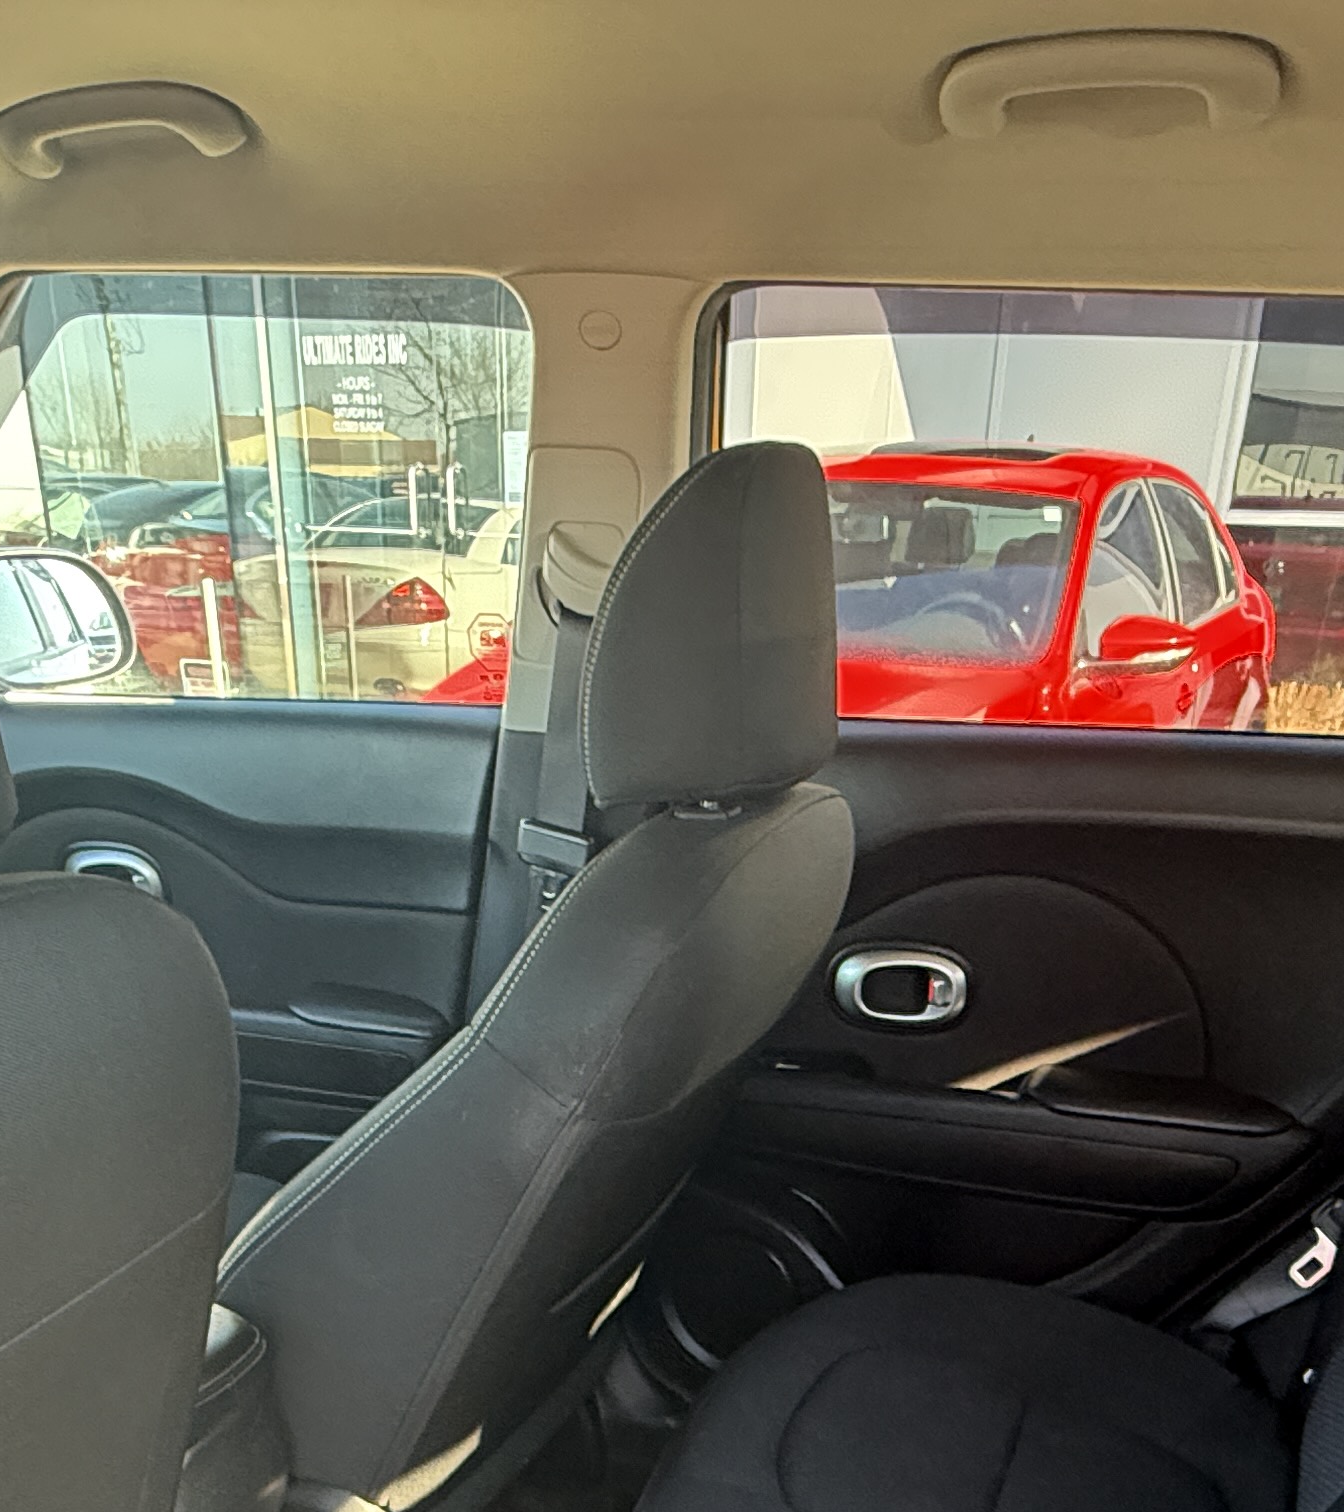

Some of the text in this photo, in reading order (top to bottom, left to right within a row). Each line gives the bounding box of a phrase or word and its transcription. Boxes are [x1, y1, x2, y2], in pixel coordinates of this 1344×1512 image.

[302, 333, 408, 366] ULTIMATE RIDES INC
